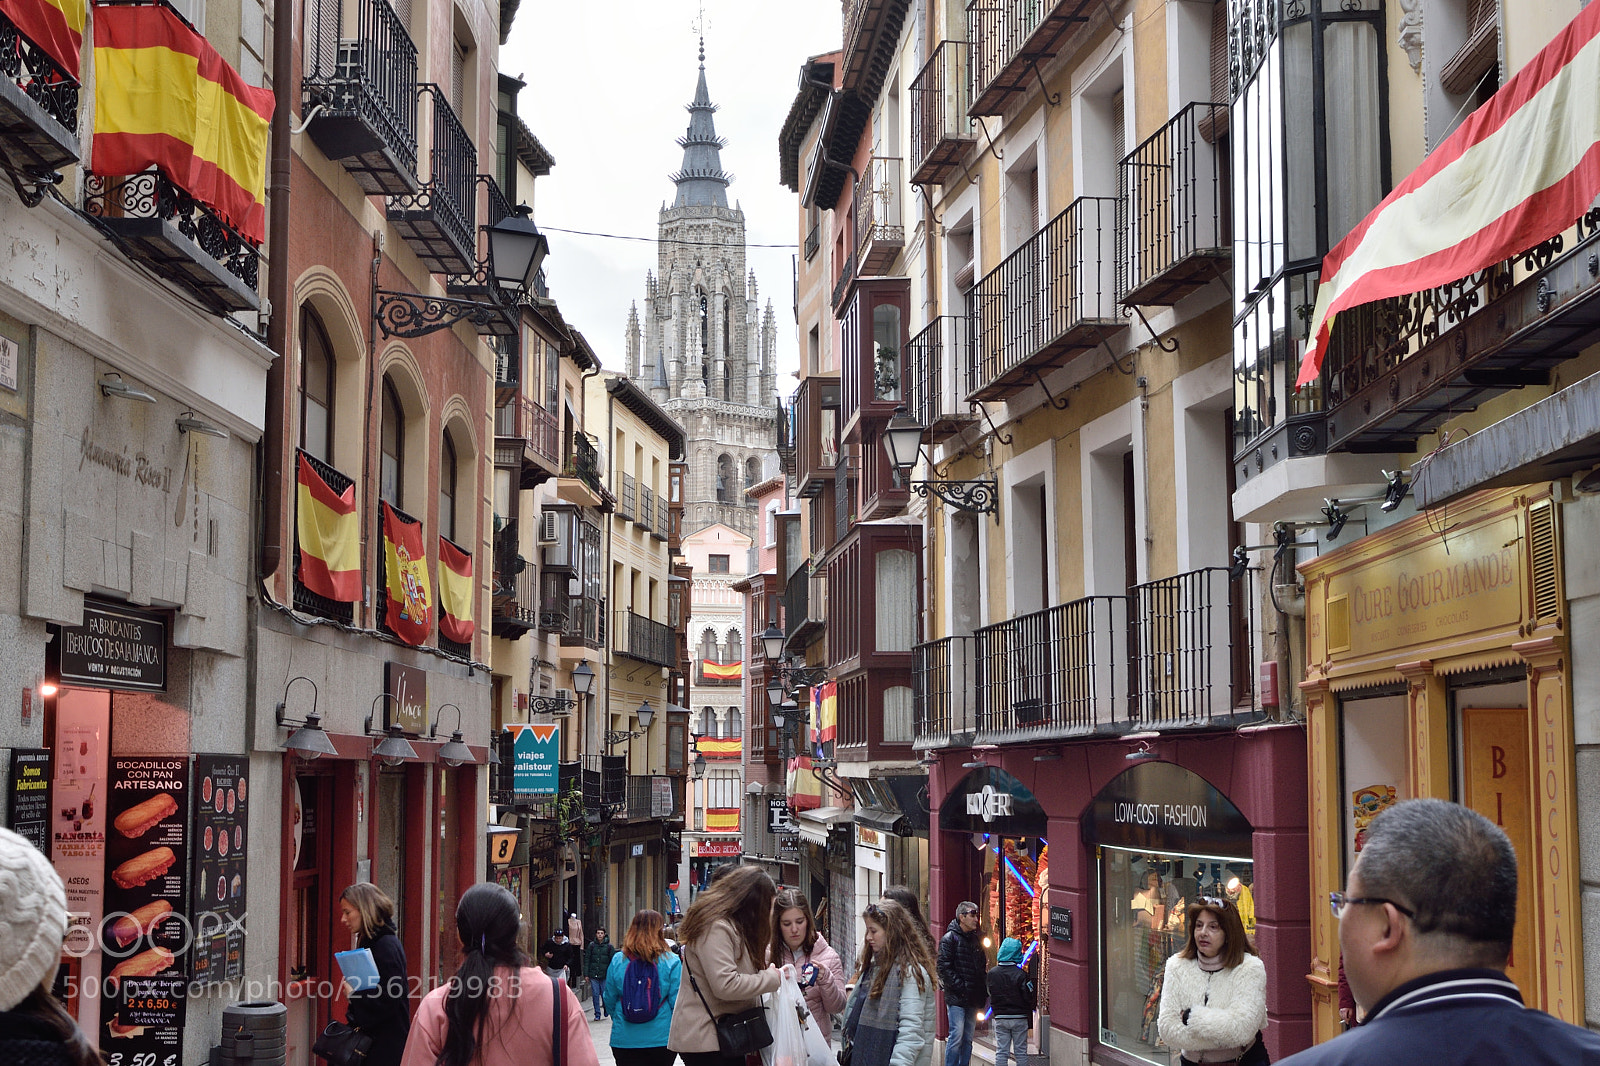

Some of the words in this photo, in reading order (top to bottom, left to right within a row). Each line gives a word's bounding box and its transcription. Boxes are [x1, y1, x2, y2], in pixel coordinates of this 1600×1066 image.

[1353, 584, 1393, 624] CURE
[1397, 549, 1513, 614] GOURMANDE
[1436, 610, 1470, 628] CHOCOLATS
[89, 617, 142, 641] FABRICANTES
[66, 632, 103, 658] IBÉRICOS
[104, 638, 114, 660] DE
[114, 640, 159, 665] SALAMANCA
[88, 661, 103, 673] VENTA
[105, 664, 110, 674] Y
[517, 751, 545, 761] viajes
[23, 765, 41, 777] Somos
[116, 761, 182, 770] BOCADILLOS
[127, 771, 149, 779] CON
[152, 771, 173, 779] PAN
[16, 779, 48, 791] Fabricantes
[114, 780, 183, 790] ARTESANO
[1114, 803, 1160, 824] LOW-COST
[1164, 805, 1207, 827] FASHION
[55, 831, 104, 840] SANGRÍA
[498, 839, 509, 858] 8
[698, 845, 721, 854] BRUNO
[1544, 694, 1564, 1021] CHOCOLATS
[68, 877, 90, 885] ASEOS
[1051, 924, 1069, 936] FASHION
[128, 998, 135, 1008] 2
[137, 1000, 144, 1008] x
[147, 998, 169, 1010] 6,50
